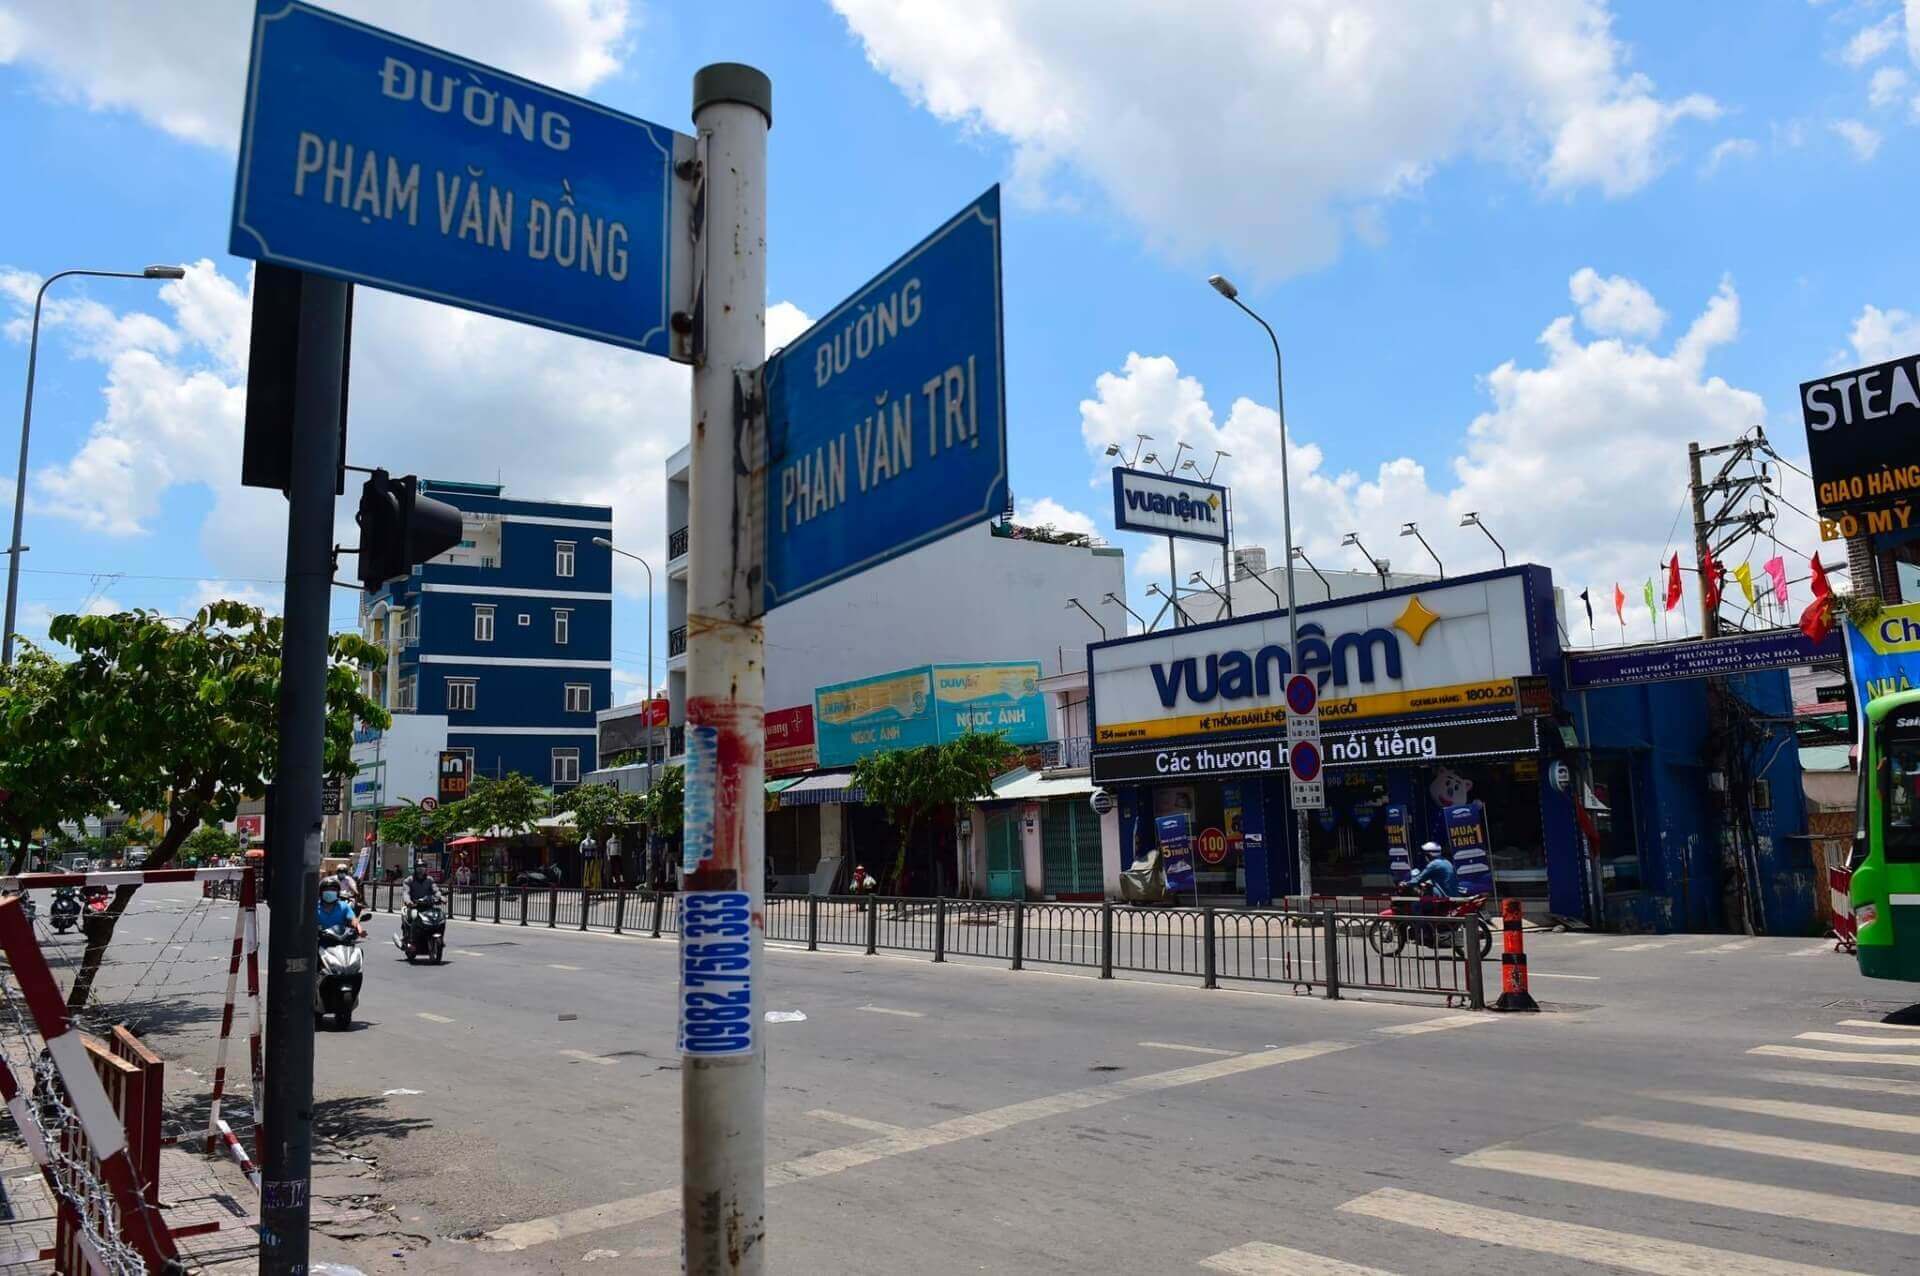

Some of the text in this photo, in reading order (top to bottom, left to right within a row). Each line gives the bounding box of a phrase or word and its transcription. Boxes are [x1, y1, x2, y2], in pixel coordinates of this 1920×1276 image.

[378, 57, 572, 151] ĐƯỜNG
[294, 132, 629, 282] PHẠM VĂN ĐỒNG
[814, 278, 922, 388] ĐƯỜNG
[1805, 361, 1920, 432] STEA
[781, 354, 979, 533] PHAN VĂN TRỊ
[1819, 463, 1920, 505] GIAO HÀNG
[1819, 500, 1912, 542] BÒ MỸ
[1156, 752, 1191, 773] Các
[1197, 748, 1272, 771] thương
[1332, 736, 1367, 760] nổi
[1374, 730, 1437, 758] tiếng
[440, 777, 465, 793] LED
[1201, 836, 1224, 851] 100
[684, 893, 750, 1051] 0982.756.333
